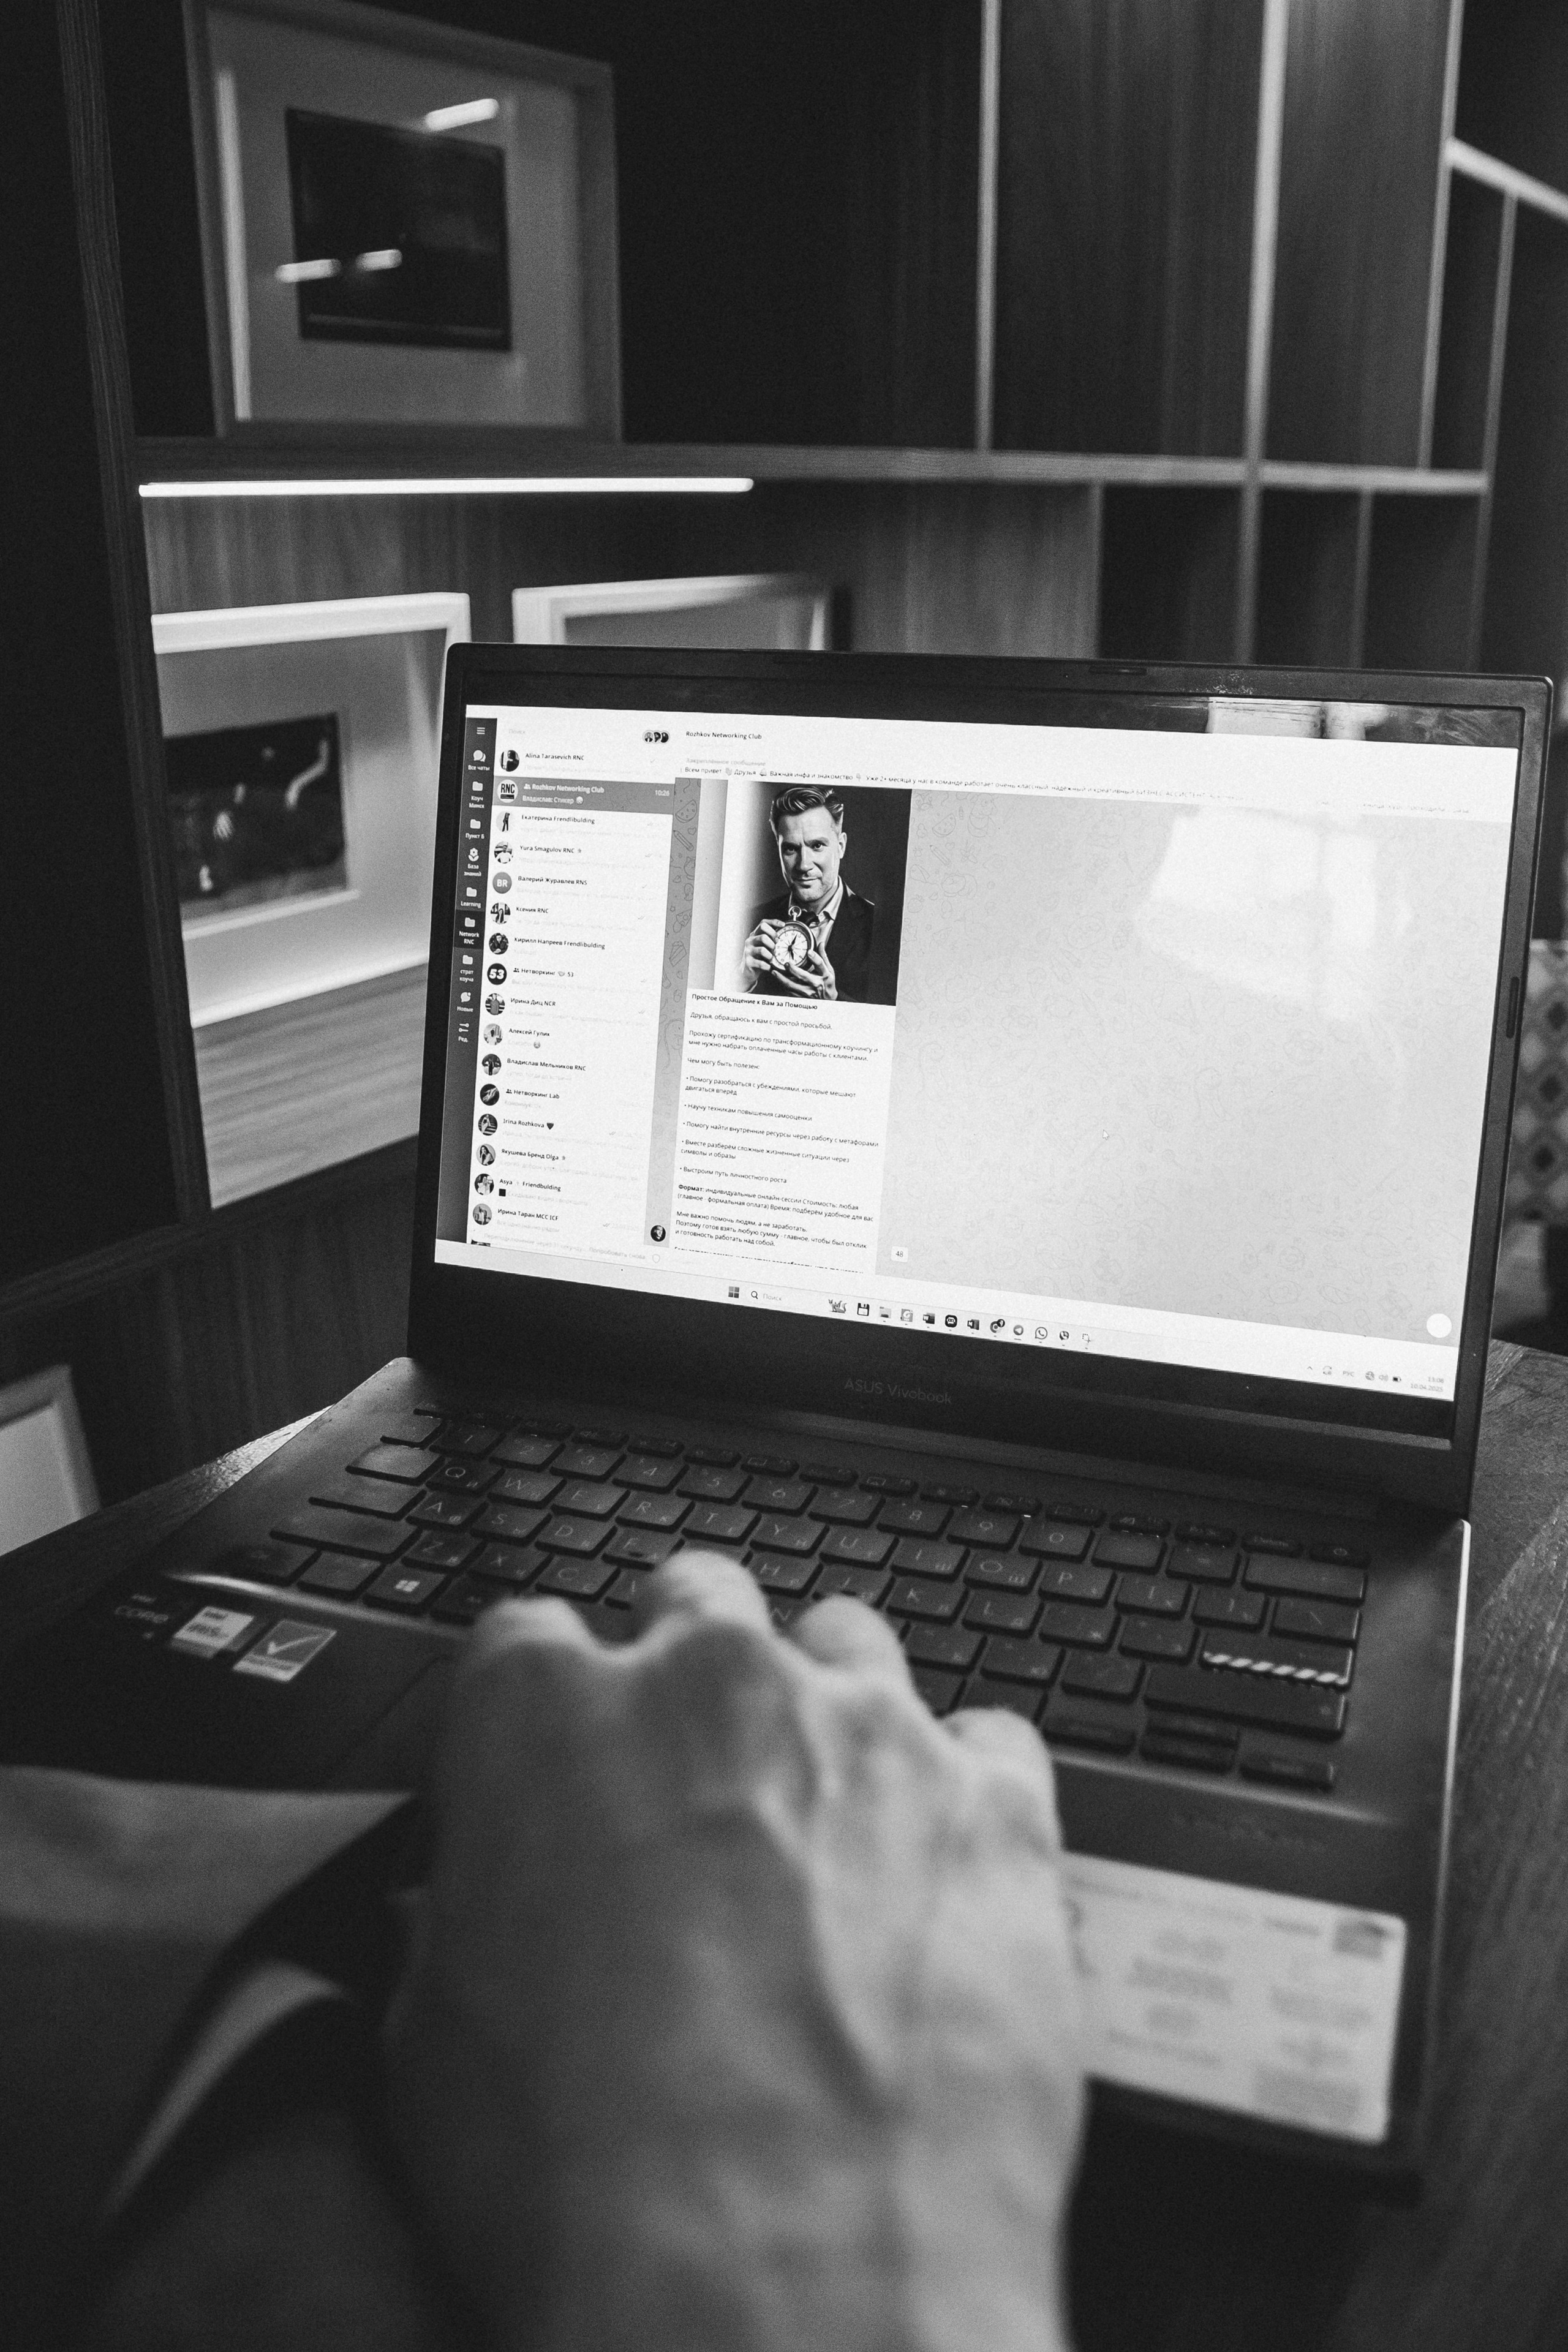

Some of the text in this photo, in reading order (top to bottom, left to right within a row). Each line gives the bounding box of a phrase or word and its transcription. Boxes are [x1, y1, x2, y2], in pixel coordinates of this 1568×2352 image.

[500, 783, 515, 794] RNC
[556, 785, 590, 794] Networking
[553, 816, 595, 824] Frendlibulding
[497, 879, 508, 888] BR
[564, 940, 605, 950] Frendlibulding
[489, 968, 505, 980] 53
[714, 1014, 750, 1022] обращаюсь
[689, 1030, 716, 1039] Прохожу
[717, 1033, 762, 1042] сертификацию
[772, 1039, 842, 1050] трансформационному
[690, 1076, 712, 1084] Помогу
[686, 1121, 709, 1130] Помогу
[729, 1172, 768, 1181] личностного
[522, 1181, 560, 1192] Friendbulding
[705, 1188, 756, 1198] индивидуальные
[757, 1194, 801, 1203] онлайн-сессии
[802, 1199, 837, 1208] Стоимость:
[707, 1197, 745, 1205] формальная
[676, 1219, 701, 1229] Поэтому
[680, 1230, 714, 1238] готовность
[844, 1378, 952, 1405] ASUS Vivobook
[445, 1467, 466, 1478] Q
[505, 1478, 530, 1491] W
[554, 1525, 574, 1537] D
